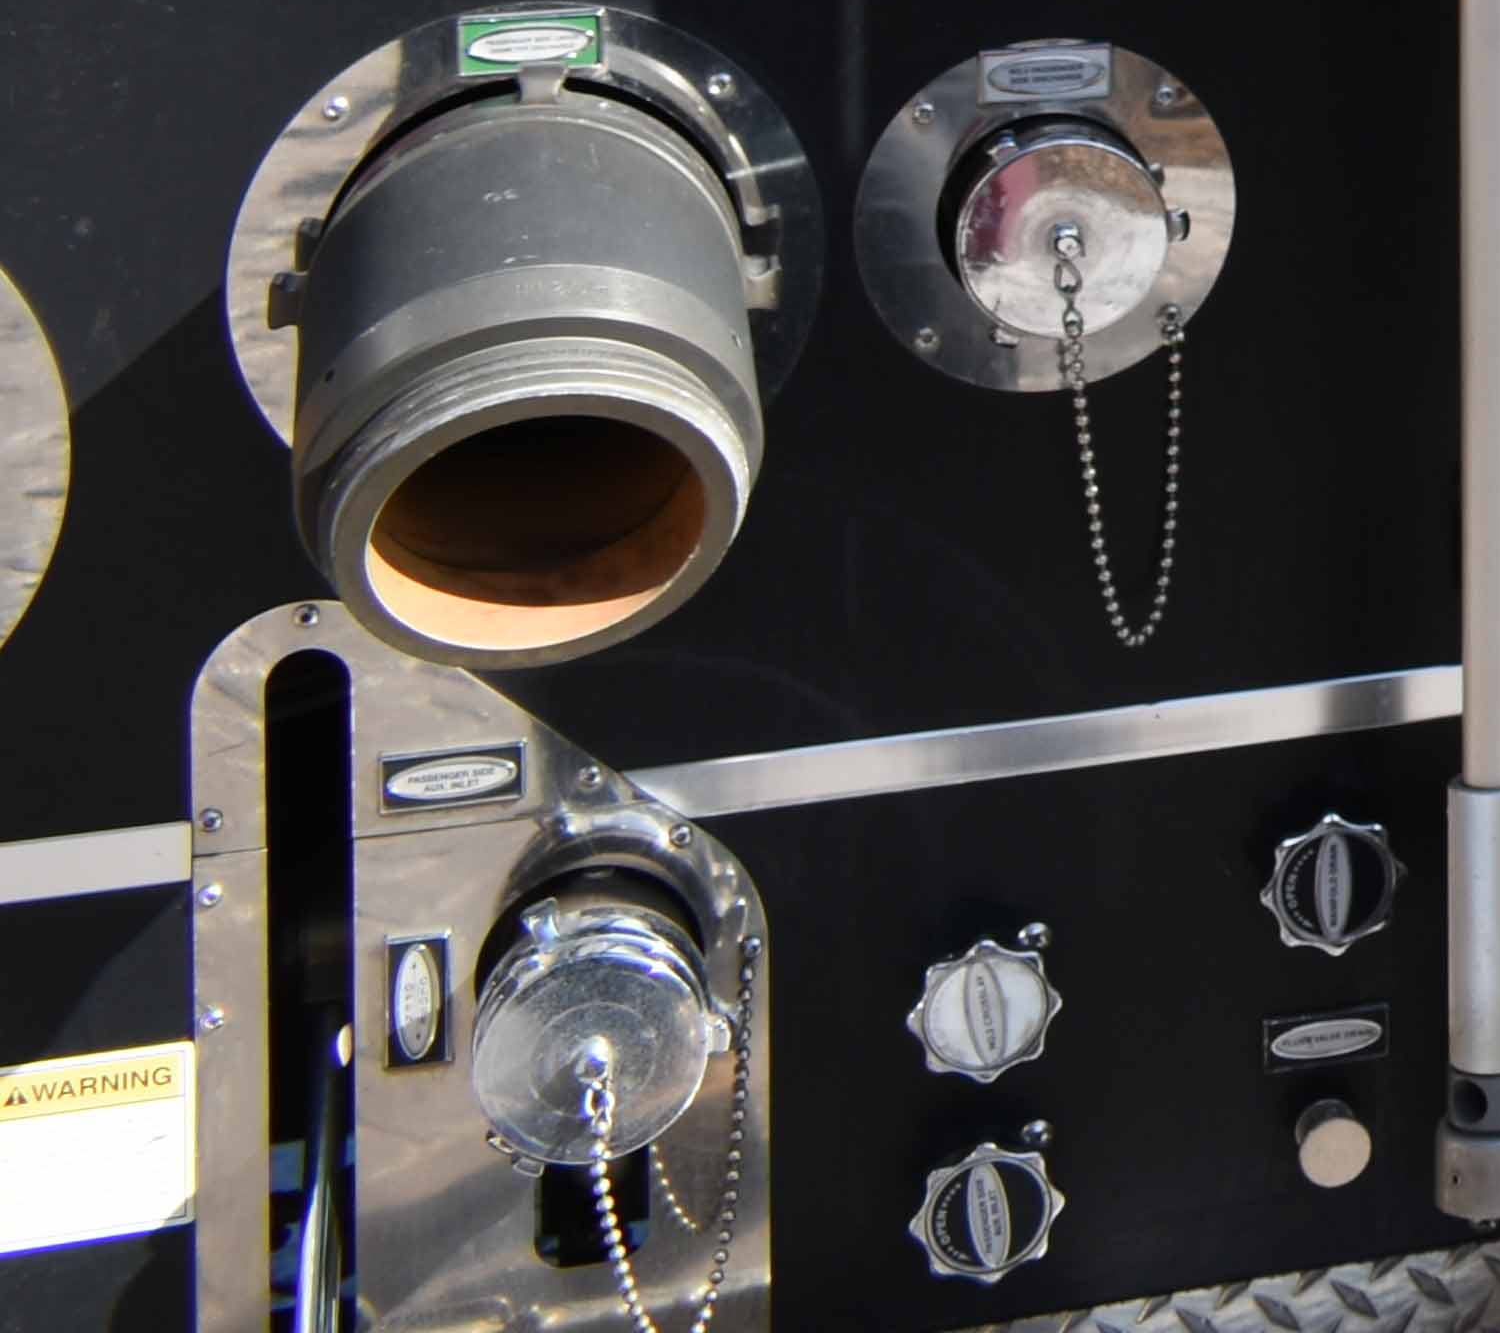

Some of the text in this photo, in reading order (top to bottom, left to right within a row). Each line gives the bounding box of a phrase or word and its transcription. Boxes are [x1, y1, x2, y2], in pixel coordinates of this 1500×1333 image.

[407, 770, 470, 784] PASSENGER
[1284, 872, 1298, 910] OPEN
[31, 1066, 173, 1102] WARNING
[934, 1207, 951, 1245] OPEN
